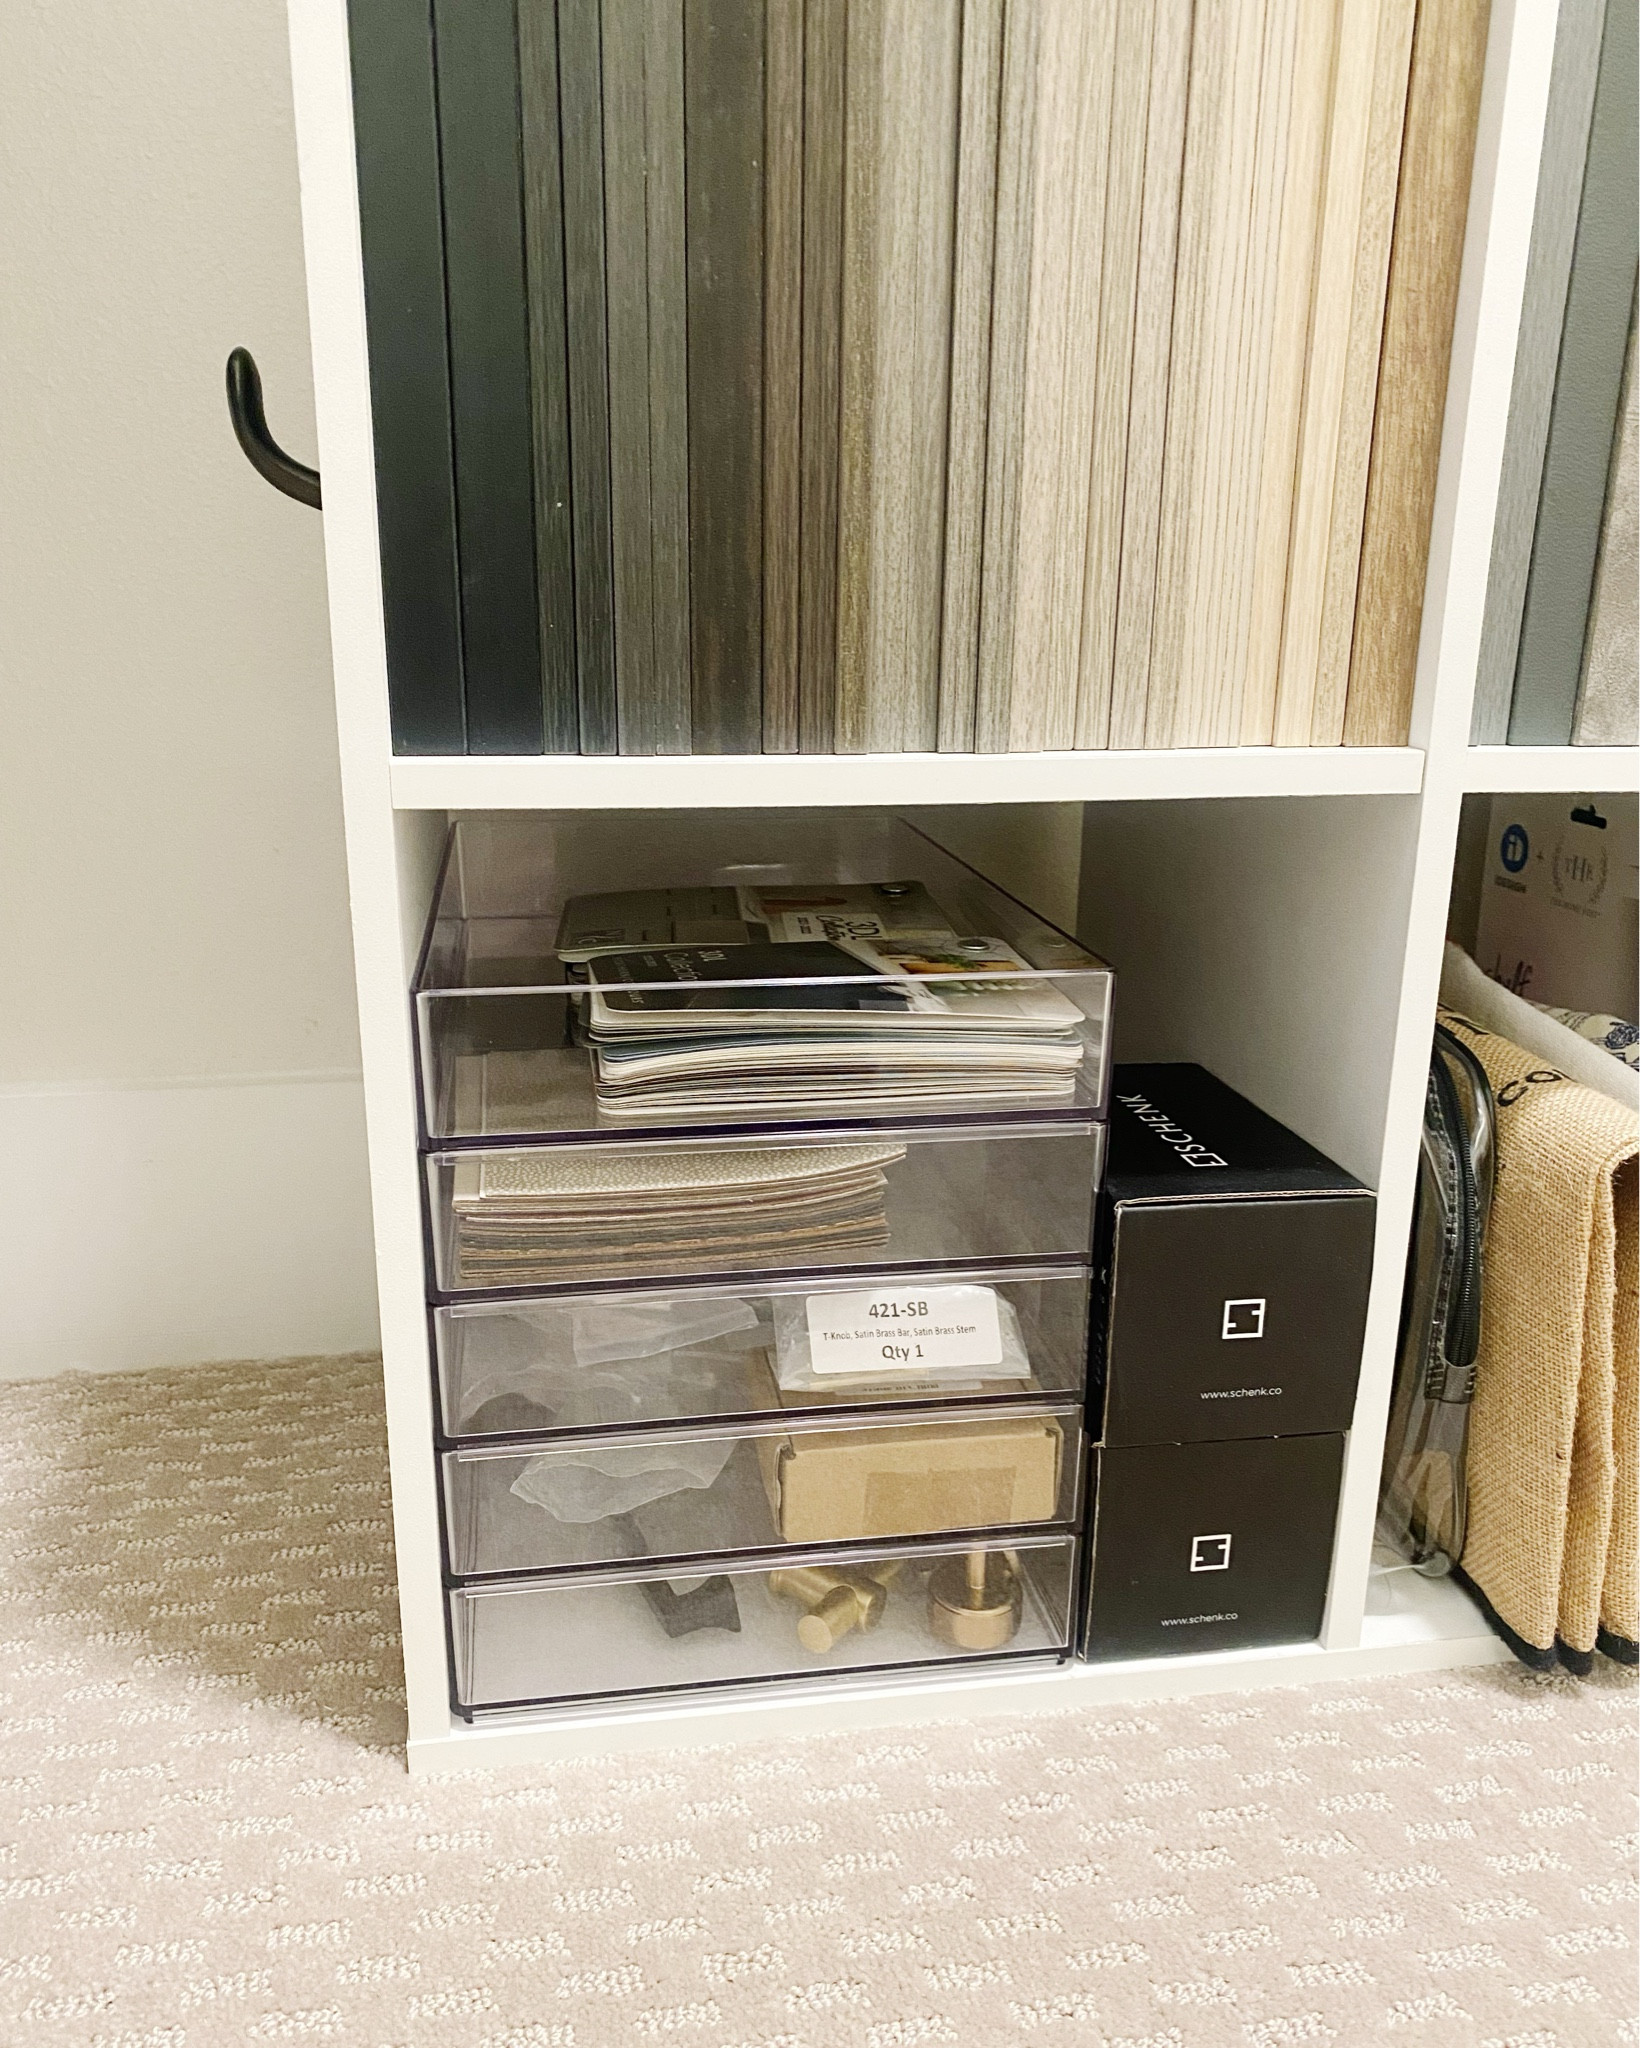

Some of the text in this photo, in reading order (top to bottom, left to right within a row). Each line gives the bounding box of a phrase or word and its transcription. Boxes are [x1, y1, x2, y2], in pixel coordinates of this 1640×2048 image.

[845, 920, 883, 940] 3DL
[663, 952, 703, 981] Collectio
[1116, 1094, 1206, 1152] SCHENK
[868, 1301, 929, 1319] 421-SB
[822, 1325, 977, 1341] T-Knob, Satin Brass Bar, Satin Brass Stem
[881, 1344, 924, 1361] Qty 1
[1200, 1386, 1283, 1400] www.schenk.co
[1161, 1612, 1239, 1627] www.schenk.co
